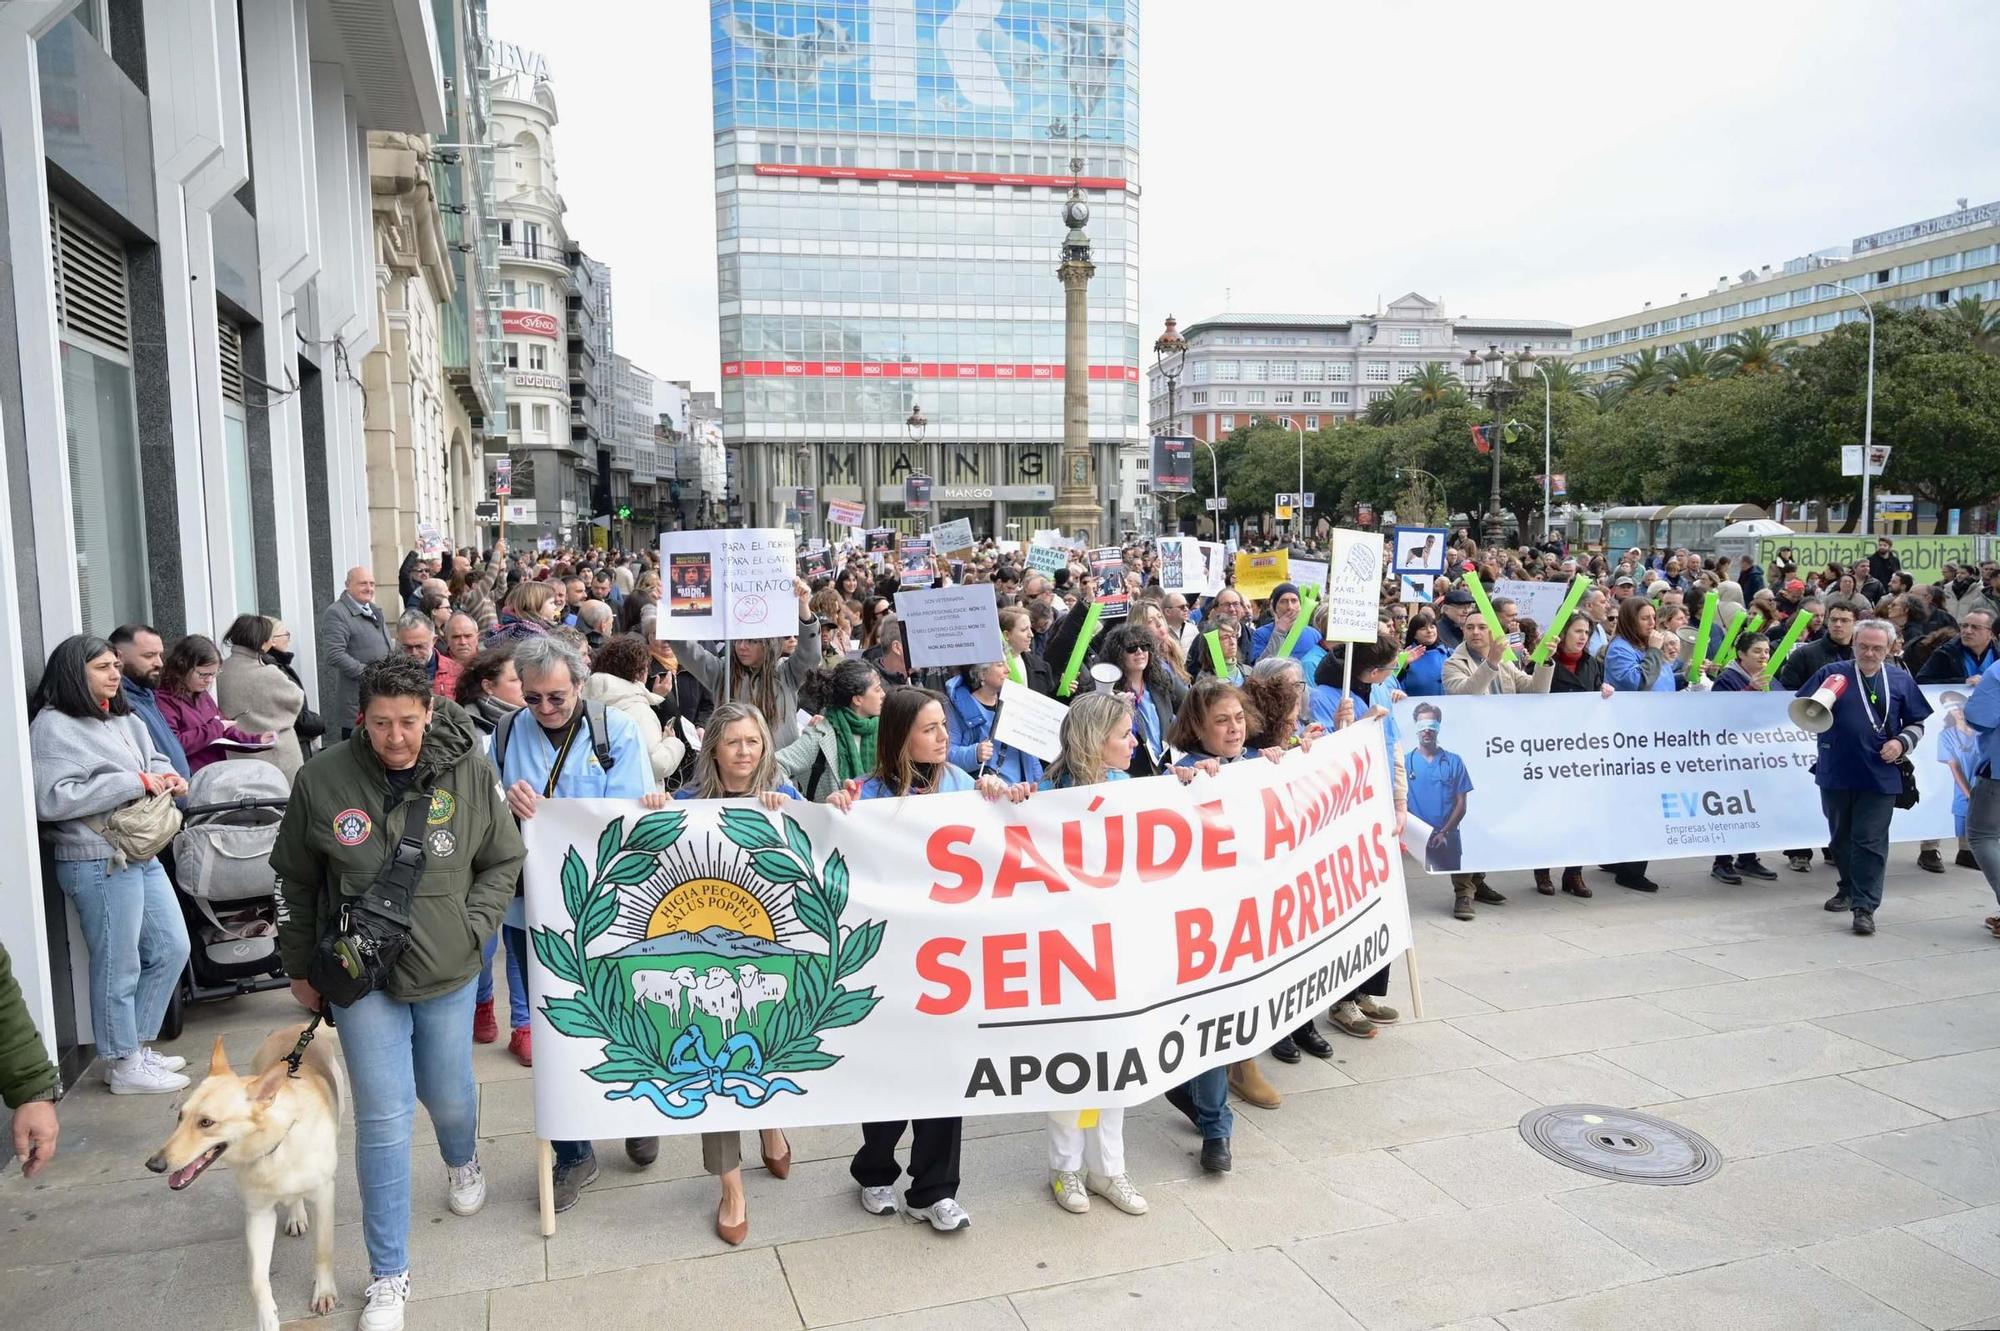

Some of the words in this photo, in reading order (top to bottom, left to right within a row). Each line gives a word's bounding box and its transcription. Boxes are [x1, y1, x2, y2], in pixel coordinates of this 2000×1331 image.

[945, 488, 993, 498] MANGO
[1280, 495, 1288, 505] P
[722, 542, 746, 553] PARA
[751, 541, 765, 551] EL
[727, 556, 750, 566] PARA
[752, 556, 766, 565] EL
[723, 579, 792, 592] MALTRATO
[1486, 736, 1515, 758] ¡Se
[1520, 732, 1610, 757] queredes
[1613, 731, 1649, 750] One
[1653, 729, 1711, 748] Health
[1716, 729, 1738, 746] de
[1523, 761, 1544, 781] ás
[1548, 756, 1656, 779] veterinarias
[1660, 760, 1672, 774] e
[1676, 751, 1788, 774] veterinarios
[1792, 752, 1818, 768] tra
[1661, 788, 1757, 819] EVGal
[925, 795, 1238, 904] SAÚDE
[1260, 745, 1375, 862] ANIMAL
[1665, 823, 1707, 836] Empresas
[1708, 819, 1761, 832] Veterinarias
[1667, 835, 1678, 846] de
[1680, 832, 1710, 844] Galicia
[661, 886, 699, 919] HIGIA
[702, 884, 761, 919] PECORIS
[667, 896, 705, 931] SALUS
[708, 896, 753, 930] POPULI
[915, 922, 1117, 1016] SEN
[1175, 822, 1390, 986] BARREIRAS
[964, 1046, 1149, 1099] APOIA
[1158, 1013, 1191, 1074] Ó
[1197, 1005, 1260, 1058] TEU
[1268, 922, 1390, 1031] VETERINARIO
